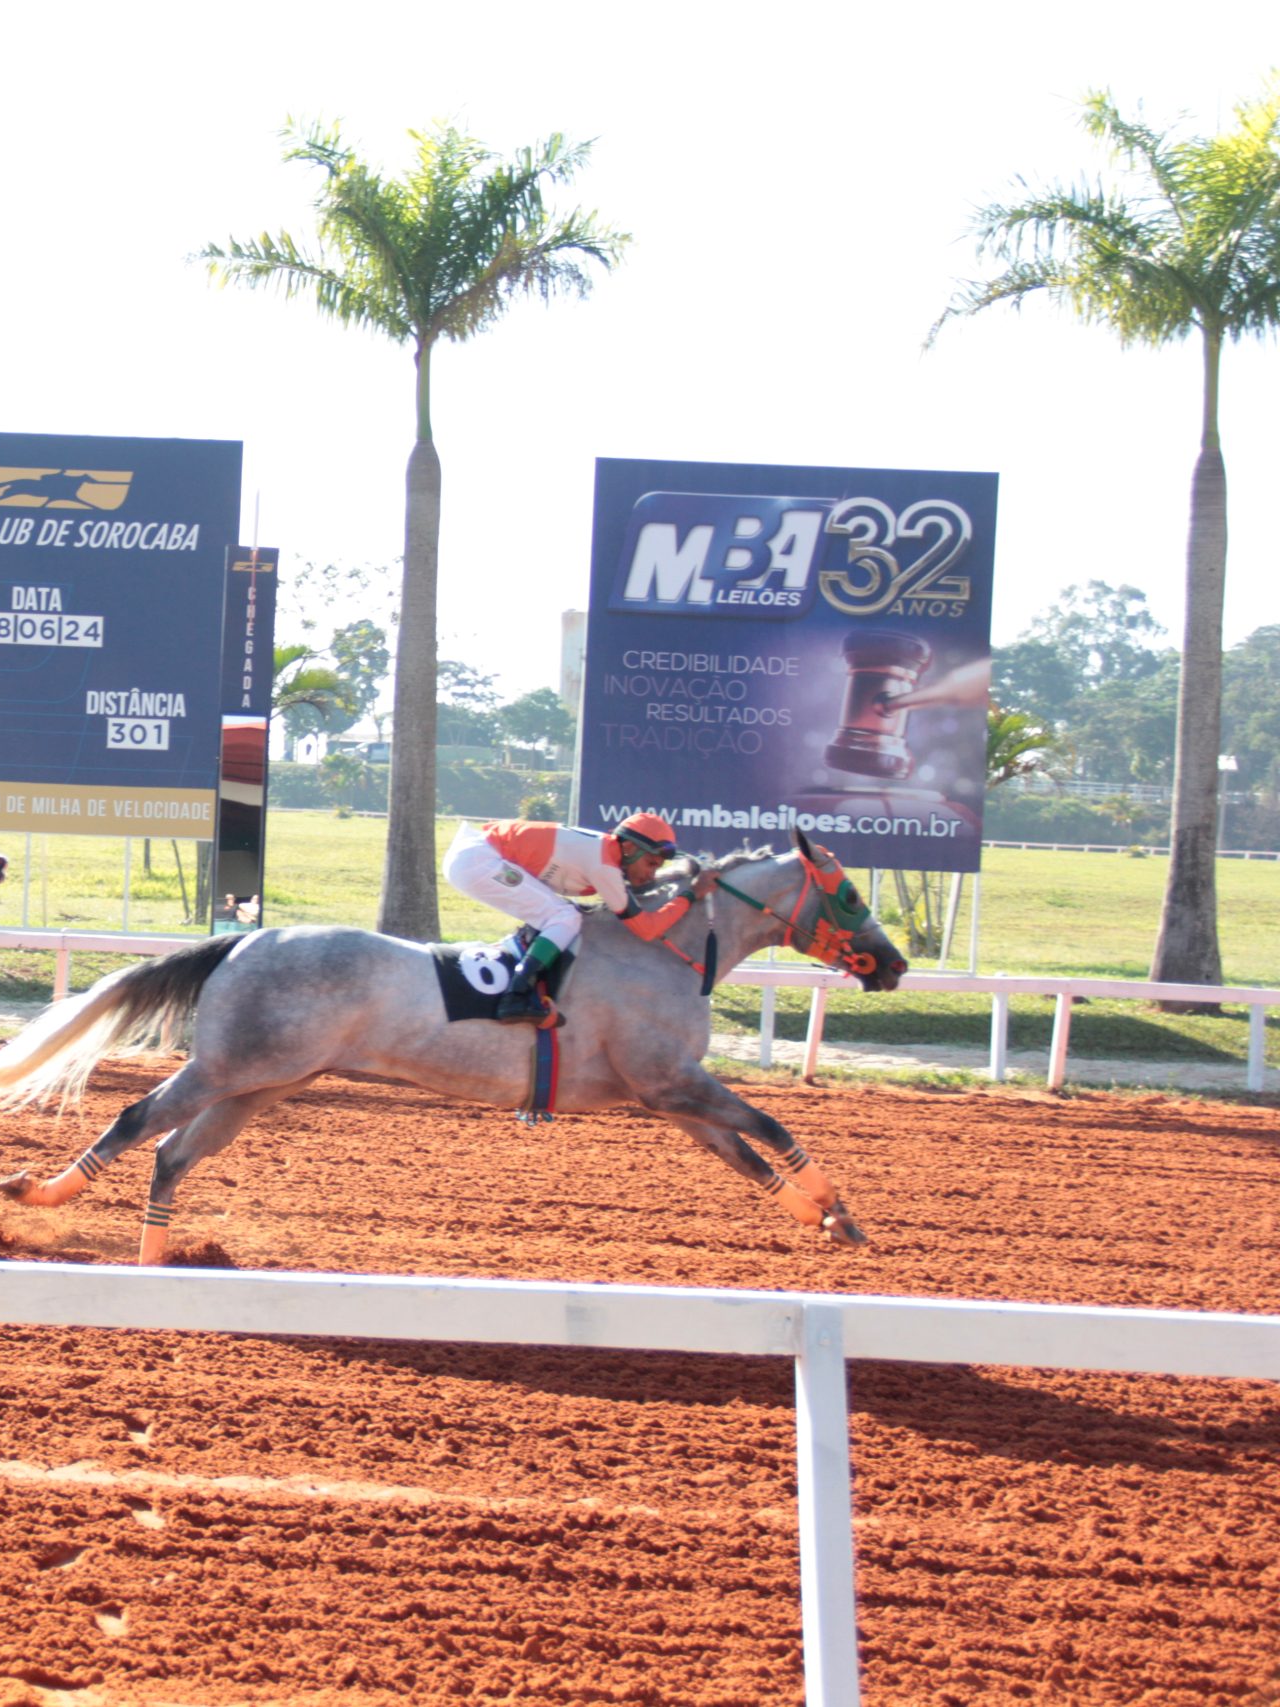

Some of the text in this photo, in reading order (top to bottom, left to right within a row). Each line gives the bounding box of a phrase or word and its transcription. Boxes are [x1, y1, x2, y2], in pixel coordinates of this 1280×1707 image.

[36, 519, 70, 547] DE
[74, 519, 201, 552] SOROCABA
[624, 496, 972, 616] MBA 32
[11, 586, 62, 612] DATA
[716, 588, 802, 606] LEILÕES
[886, 600, 966, 619] ANOS
[242, 585, 257, 709] CHEGADA
[622, 650, 800, 677] CREDIBILIDADE
[603, 674, 748, 702] INOVAÇÃO
[86, 688, 186, 718] DISTÂNCIA
[646, 703, 793, 727] RESULTADOS
[110, 723, 164, 746] 301
[601, 723, 764, 759] TRADIÇÃO
[6, 796, 27, 813] DE
[32, 797, 81, 817] MILHA
[87, 799, 106, 818] DE
[113, 800, 211, 820] VELOCIDADE
